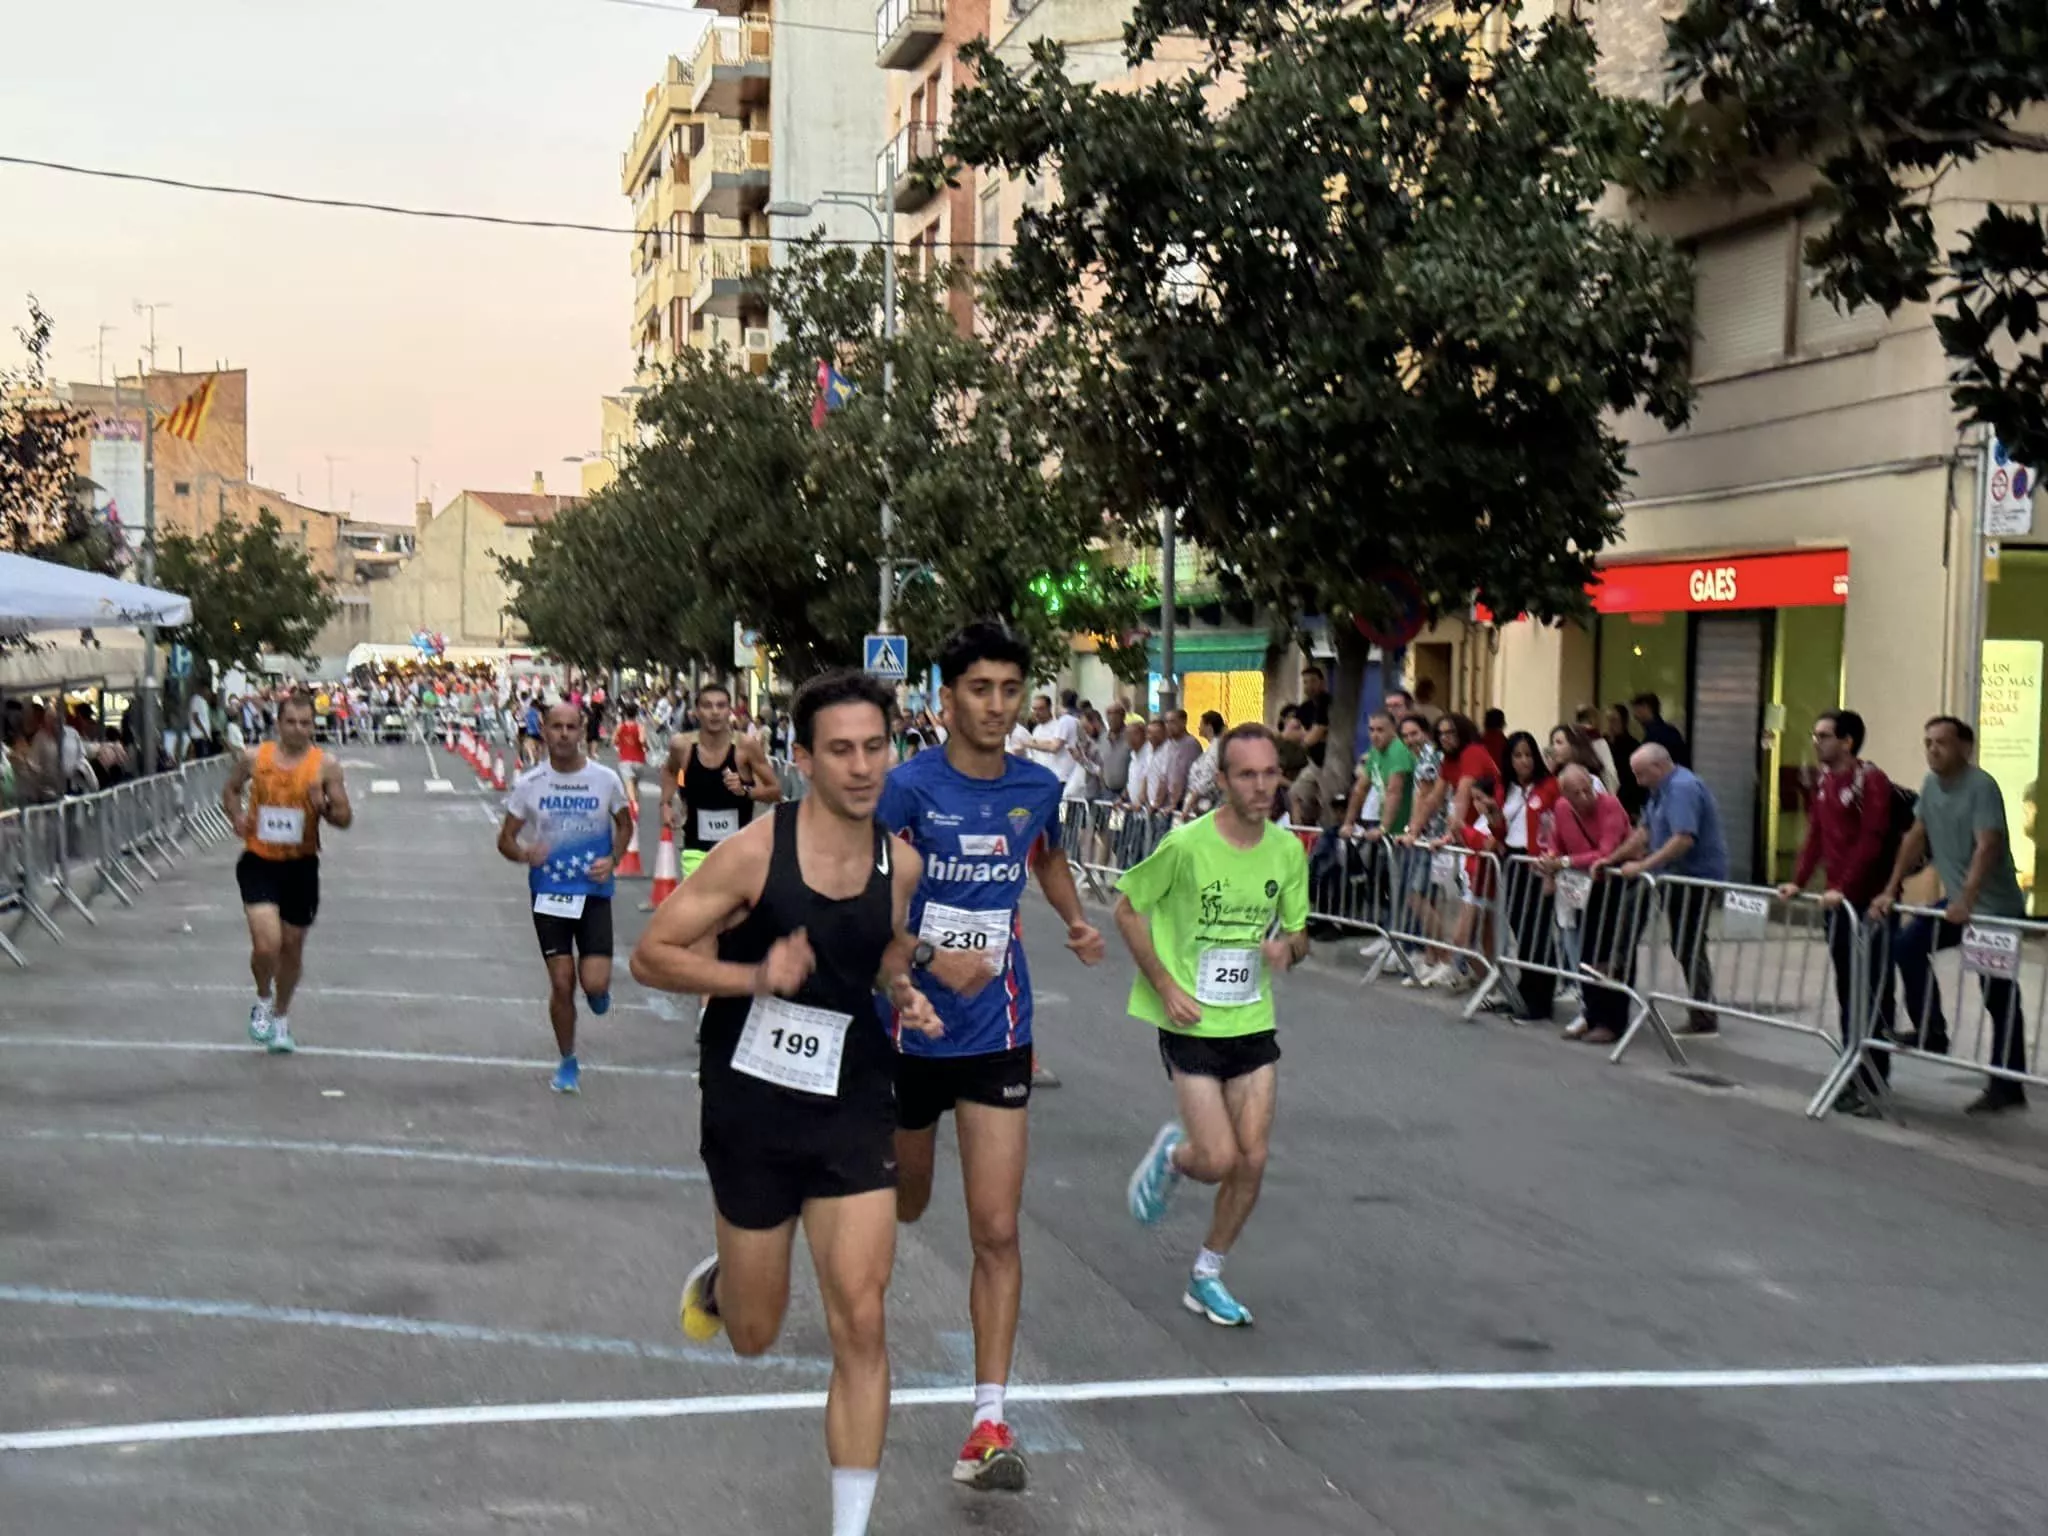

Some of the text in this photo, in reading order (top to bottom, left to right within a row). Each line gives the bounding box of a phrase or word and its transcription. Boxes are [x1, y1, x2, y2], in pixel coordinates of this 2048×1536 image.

[1689, 567, 1737, 602] GAES
[1980, 675, 2004, 687] ASO
[1979, 715, 2005, 728] ADA
[539, 795, 600, 810] MADRID
[927, 852, 1021, 882] hinaco
[940, 930, 987, 950] 230
[1215, 967, 1249, 984] 250
[771, 1028, 819, 1058] 199
